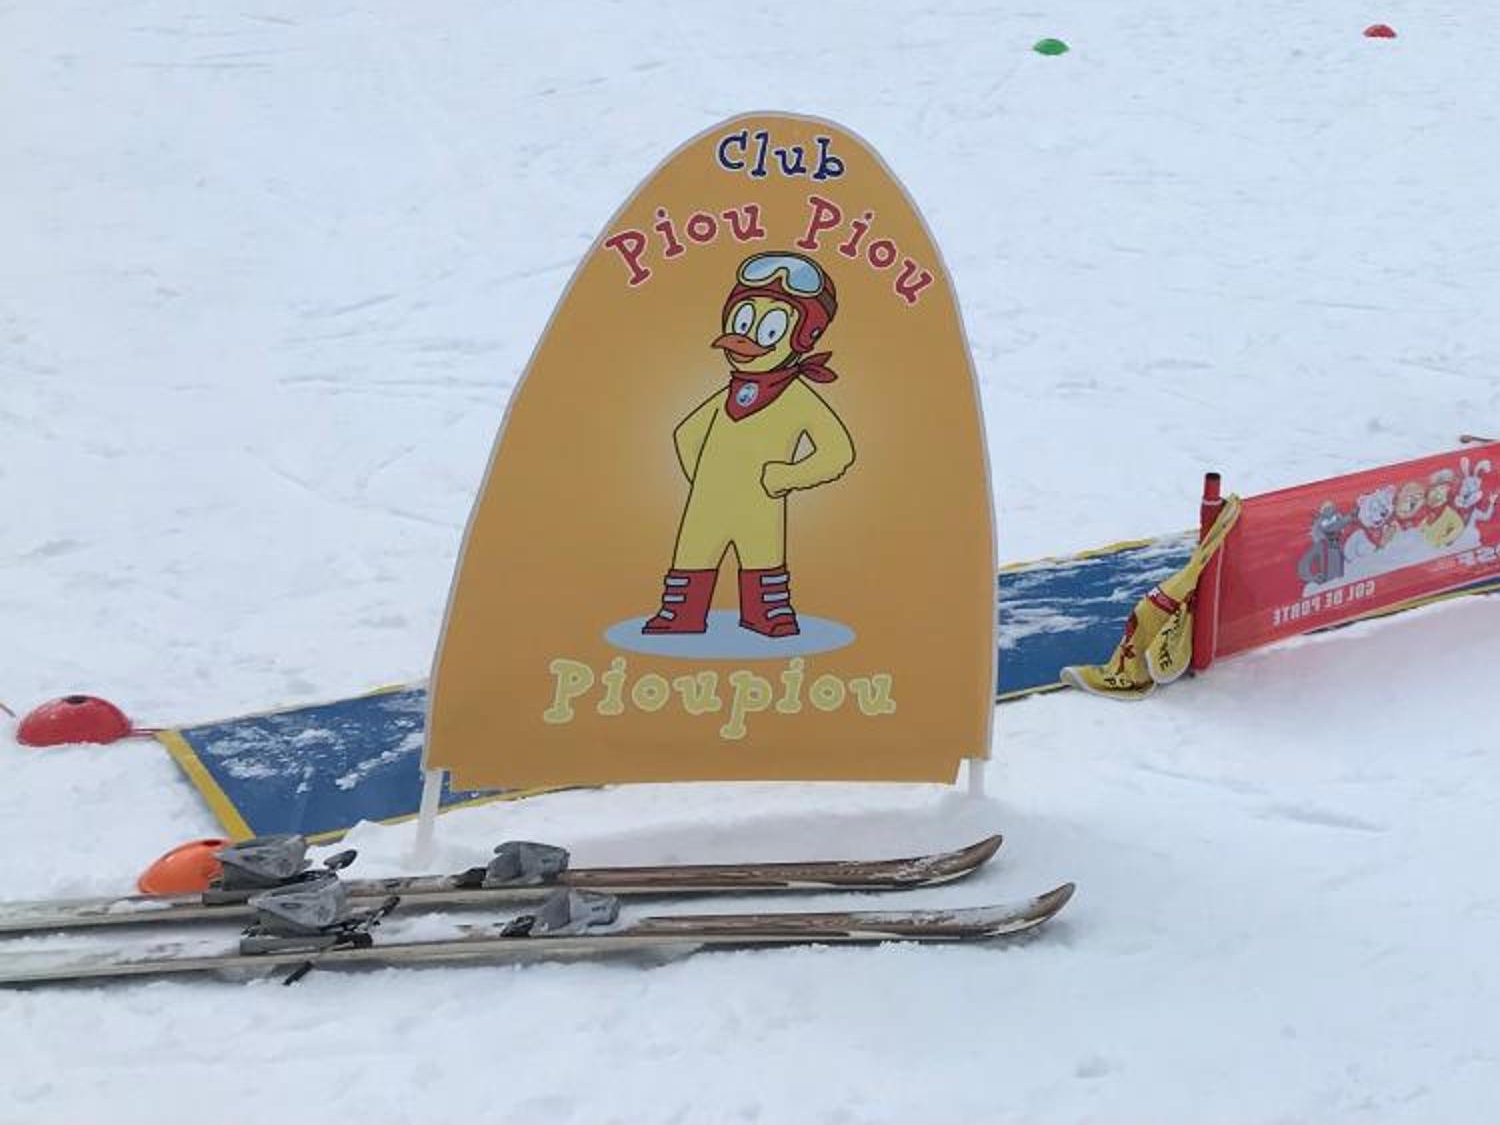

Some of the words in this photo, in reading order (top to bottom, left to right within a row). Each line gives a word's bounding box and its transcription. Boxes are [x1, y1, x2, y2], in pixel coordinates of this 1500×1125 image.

[717, 131, 845, 179] Club
[605, 203, 766, 286] Piou
[797, 196, 934, 305] Piou
[543, 657, 897, 740] Pioupiou
